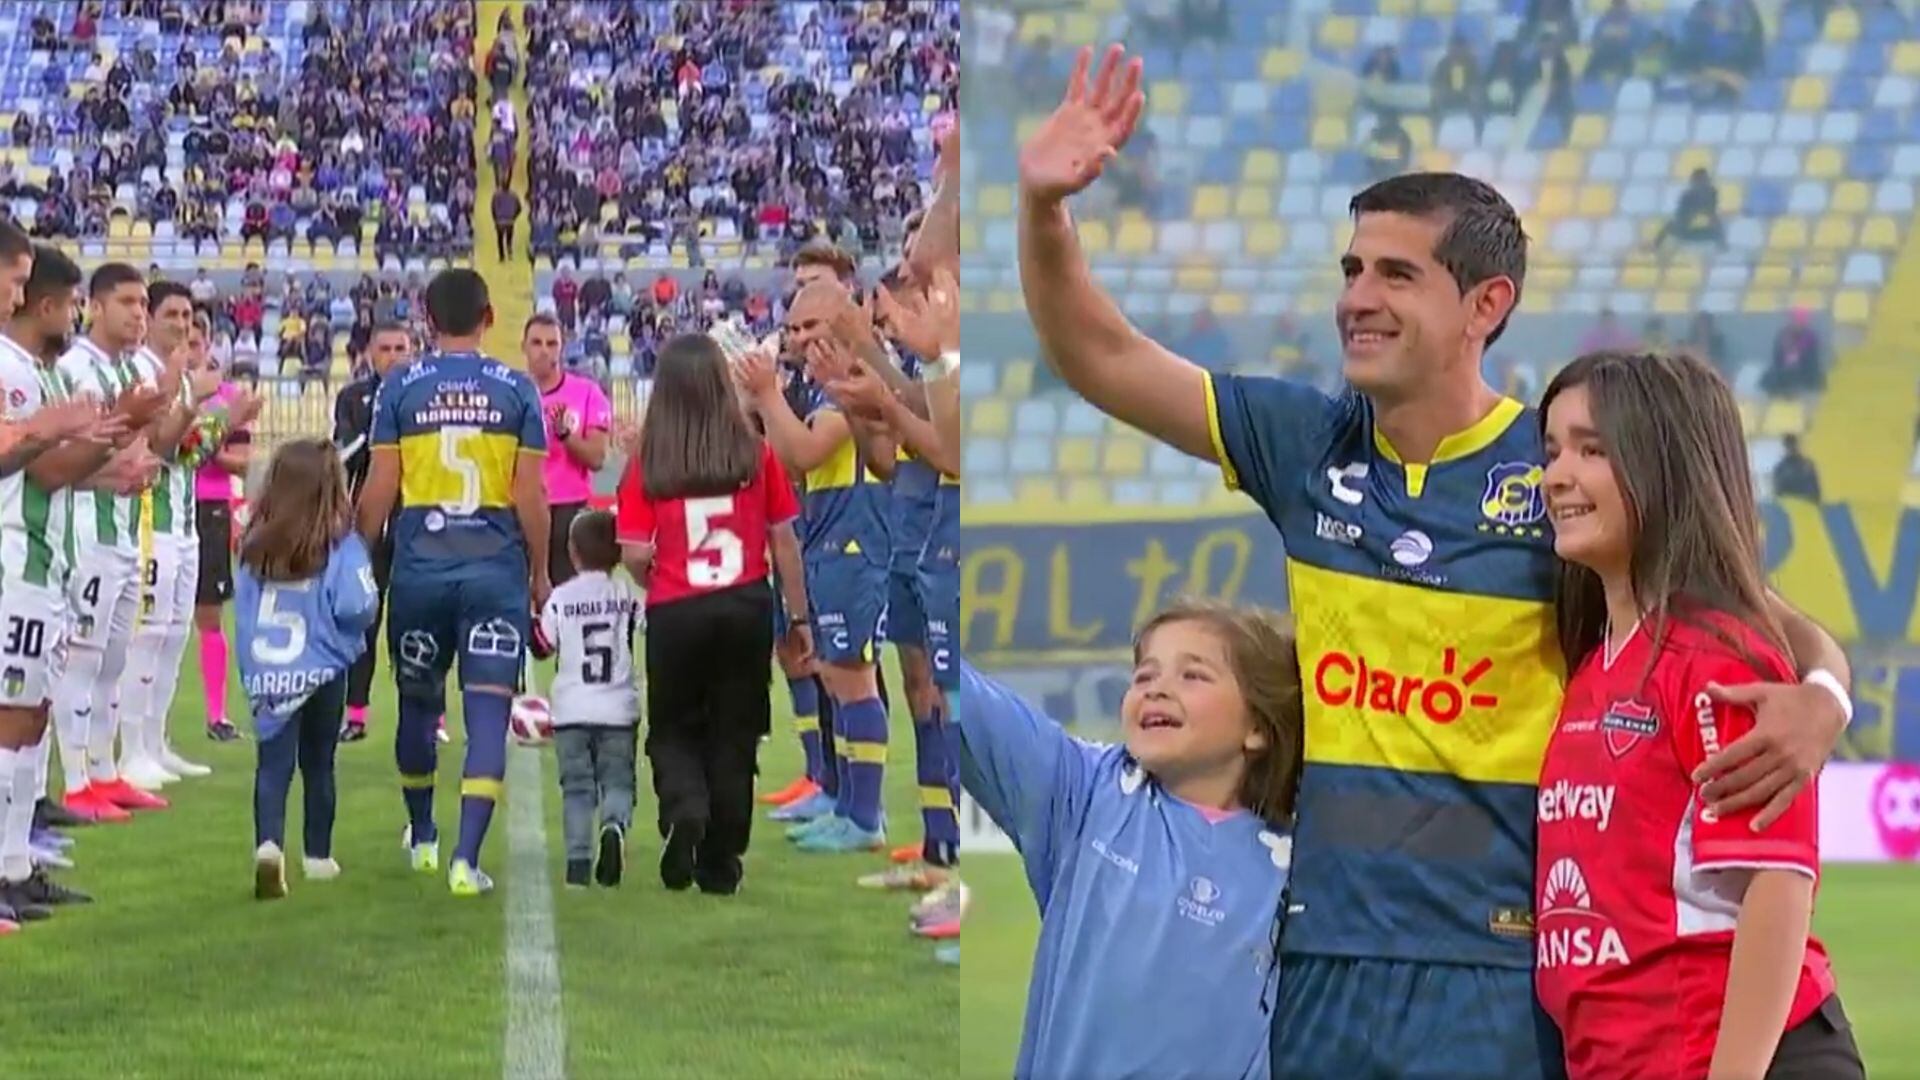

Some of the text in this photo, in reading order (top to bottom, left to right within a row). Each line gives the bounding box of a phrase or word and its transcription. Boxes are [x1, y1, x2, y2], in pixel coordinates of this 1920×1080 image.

[415, 408, 502, 425] BARROSO
[441, 426, 482, 515] 5
[685, 496, 743, 587] 5
[83, 576, 100, 607] 4
[4, 615, 44, 658] 30
[252, 578, 307, 665] 5
[582, 623, 612, 684] 5
[1315, 651, 1463, 724] Claro
[1537, 780, 1615, 832] etway
[1537, 927, 1630, 968] ANSA
